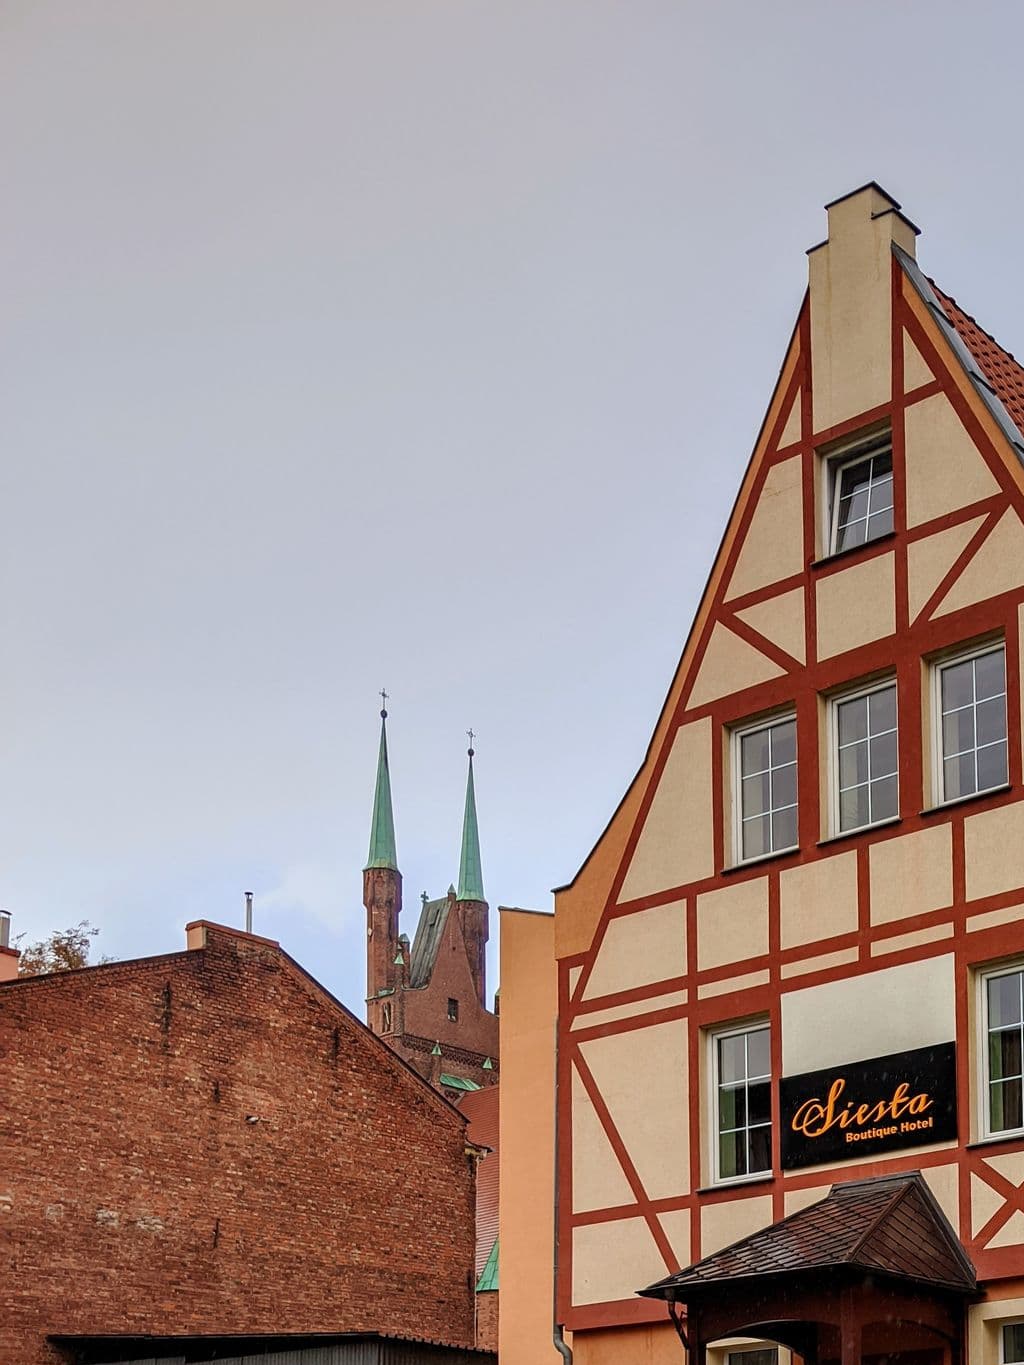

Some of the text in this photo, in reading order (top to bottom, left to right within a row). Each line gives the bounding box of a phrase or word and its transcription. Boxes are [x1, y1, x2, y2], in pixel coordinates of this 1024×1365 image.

[791, 1078, 934, 1138] Siesta
[845, 1116, 933, 1143] Boutique Hotel
